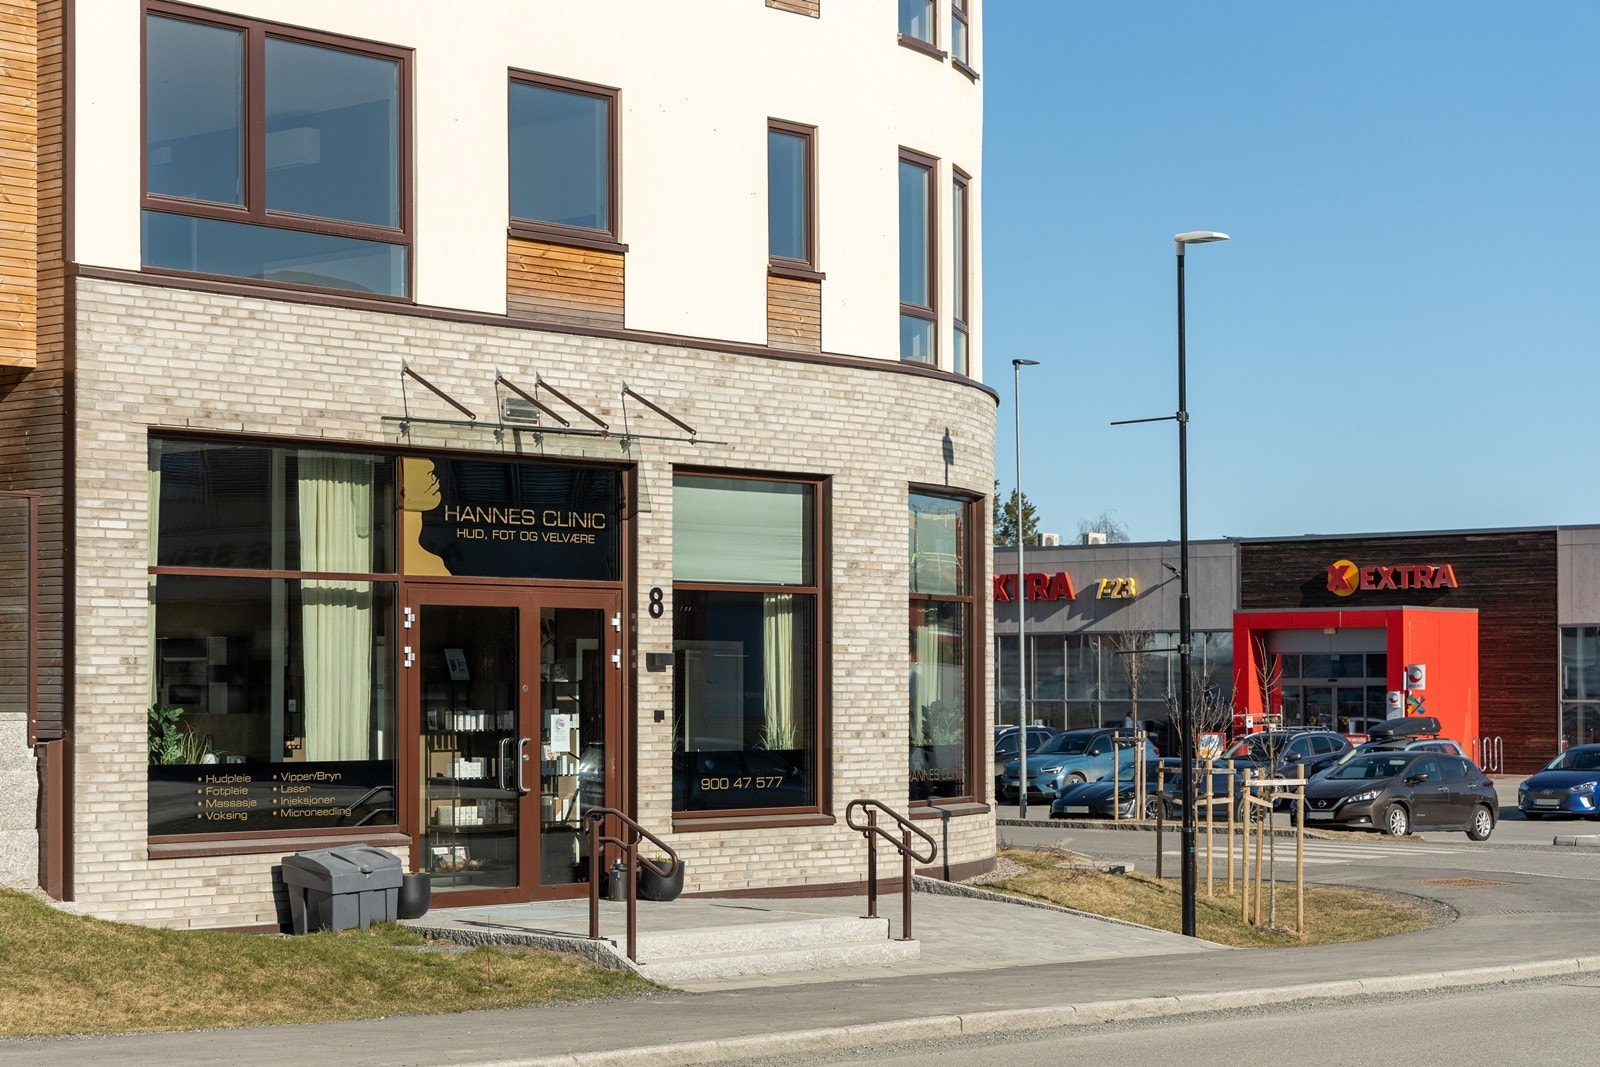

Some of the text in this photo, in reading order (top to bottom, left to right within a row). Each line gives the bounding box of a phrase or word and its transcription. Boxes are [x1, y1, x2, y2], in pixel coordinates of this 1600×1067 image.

[445, 505, 606, 529] HANNES CLINIC
[456, 528, 596, 544] HUD, FOT OG VELVÆRE
[1359, 564, 1458, 590] EXTRA
[993, 572, 1076, 602] XTRA
[1094, 578, 1138, 599] 7-23
[648, 587, 664, 619] 8
[206, 774, 252, 785] Hudpleie
[280, 772, 342, 782] Vipper/Bryn
[701, 776, 783, 790] 900 47 577
[206, 786, 248, 797] Fotpleie
[280, 784, 310, 794] Laser
[206, 798, 257, 809] Massasje
[280, 796, 336, 806] Injeksjoner
[206, 811, 248, 822] Voksing
[280, 807, 352, 818] Microneedling
